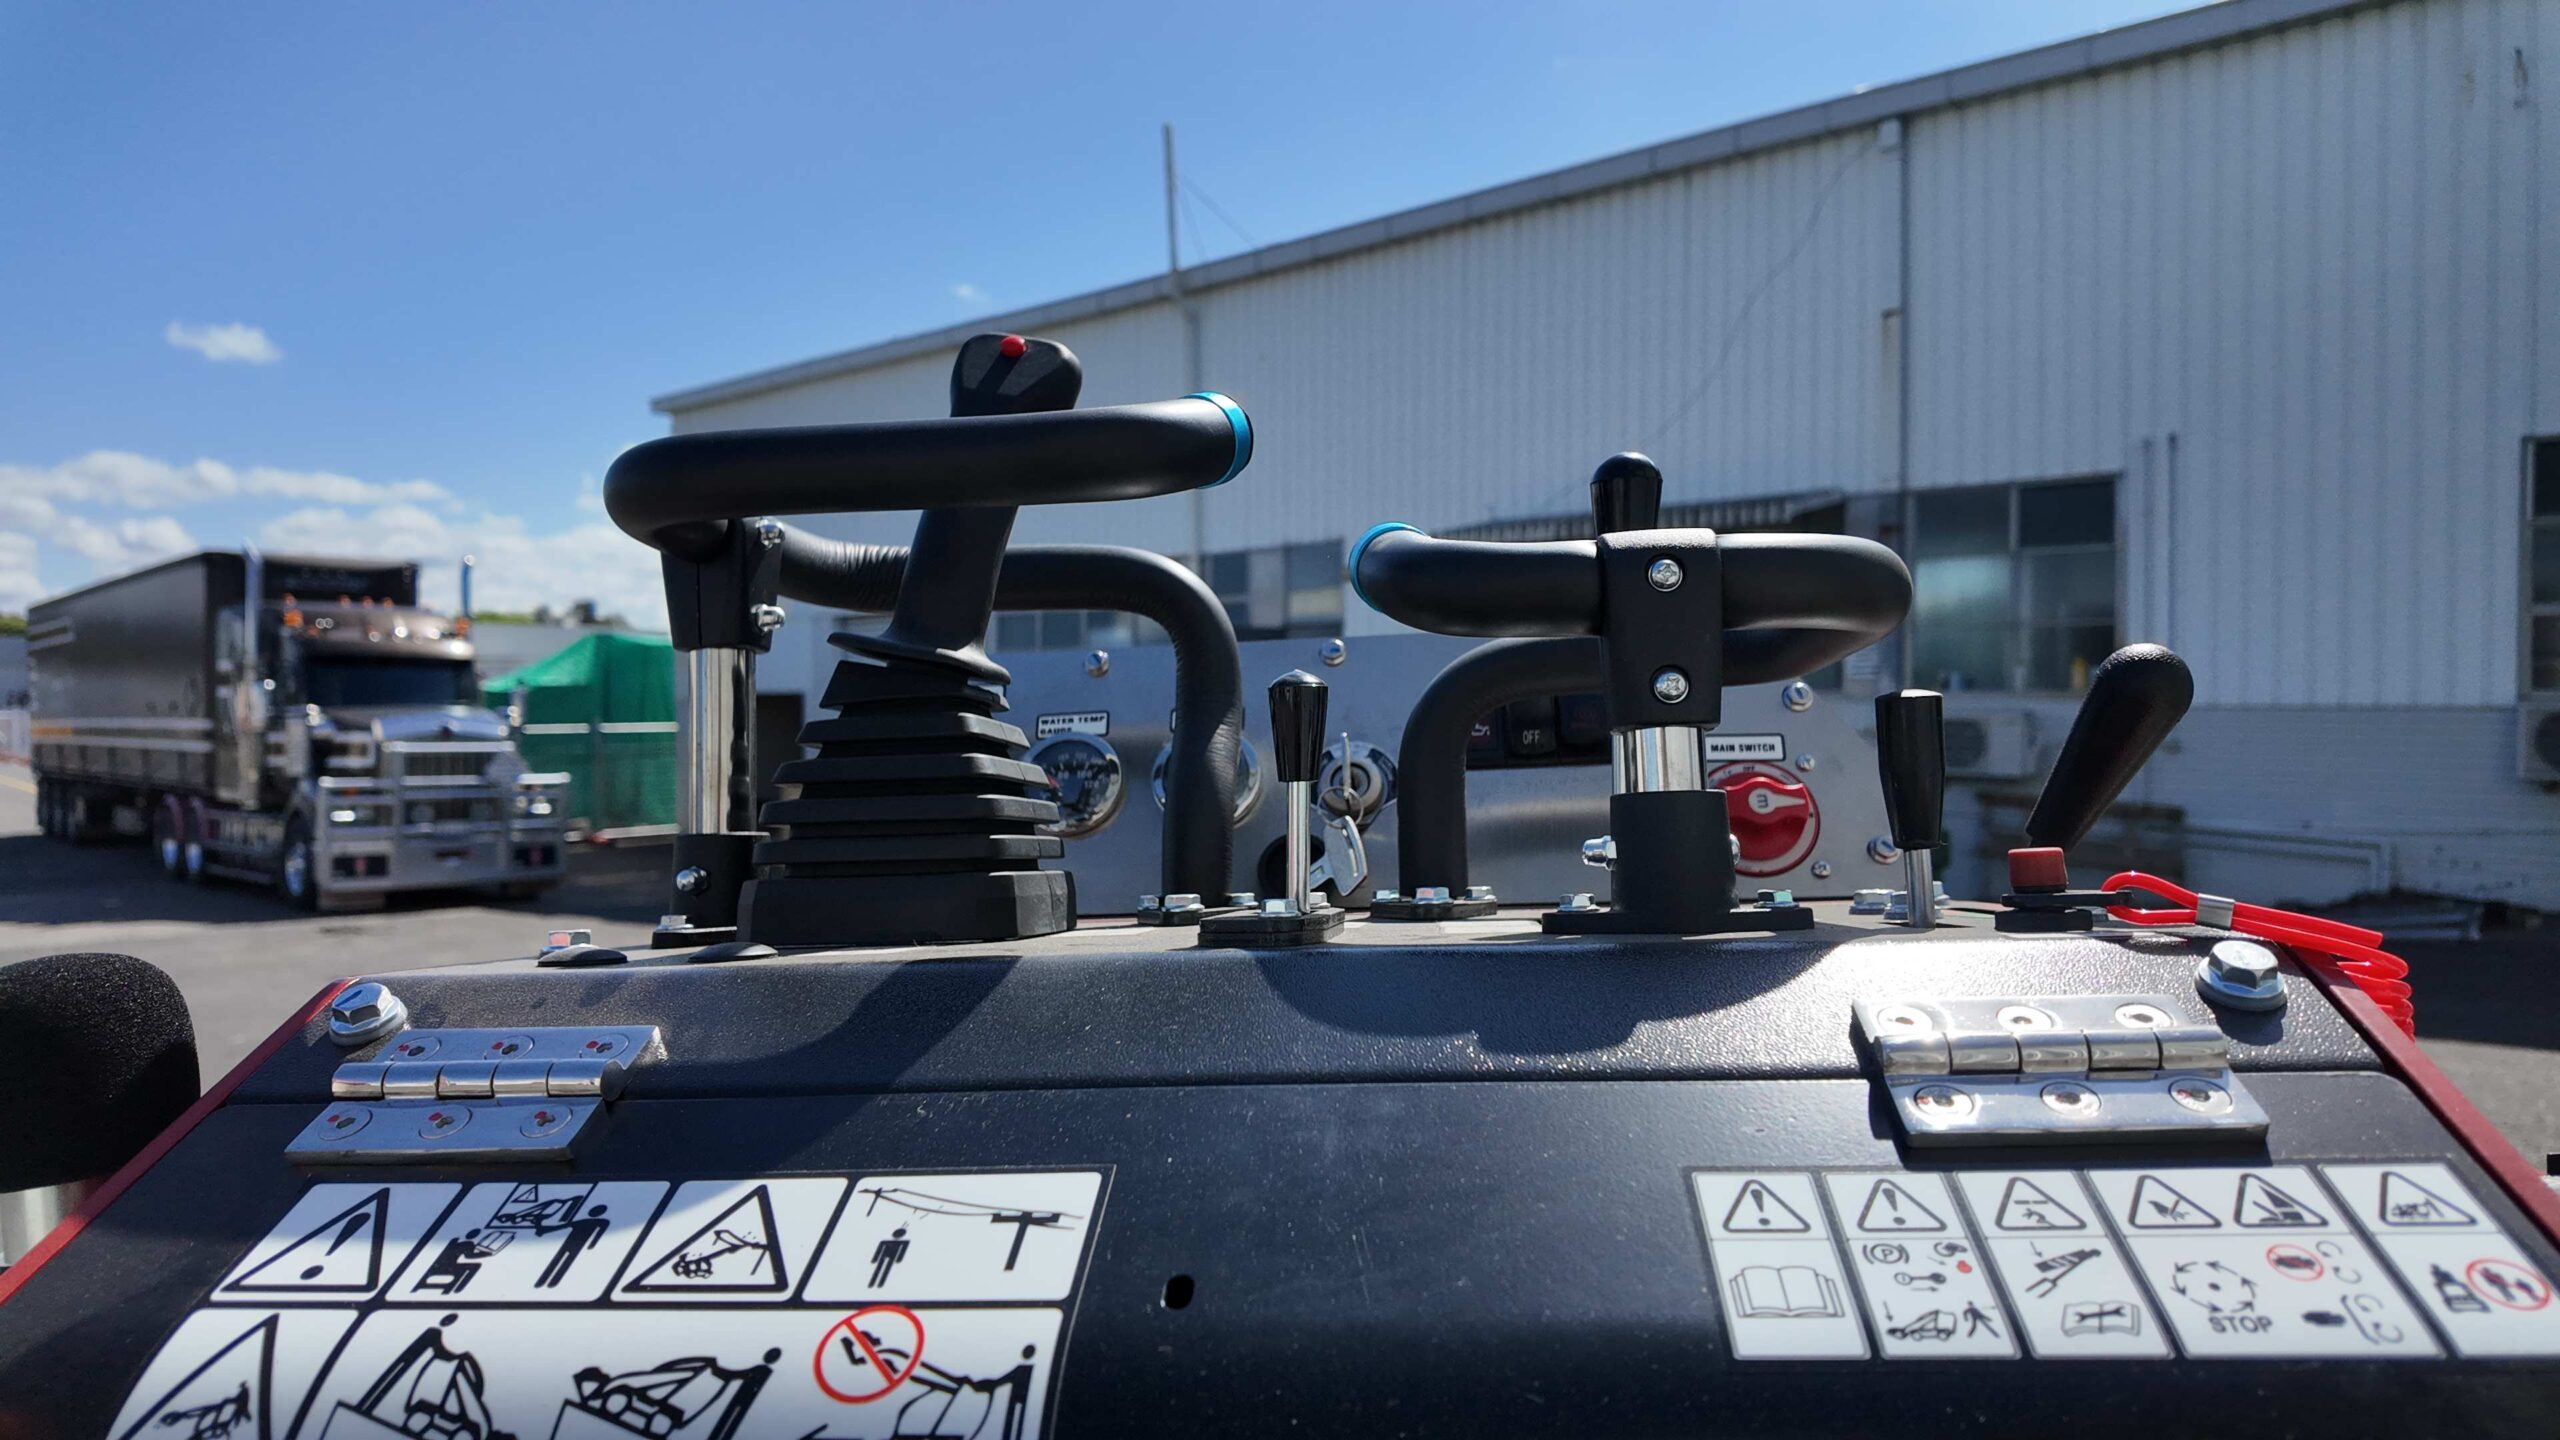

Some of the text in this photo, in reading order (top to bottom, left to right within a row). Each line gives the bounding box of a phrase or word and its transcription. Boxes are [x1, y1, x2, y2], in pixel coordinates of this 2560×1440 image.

[1041, 718, 1074, 726] WATER
[1522, 729, 1541, 745] OFF
[1710, 743, 1776, 752] MAIN SWITCH
[1881, 1248, 1894, 1260] P
[2208, 1315, 2273, 1333] STOP
